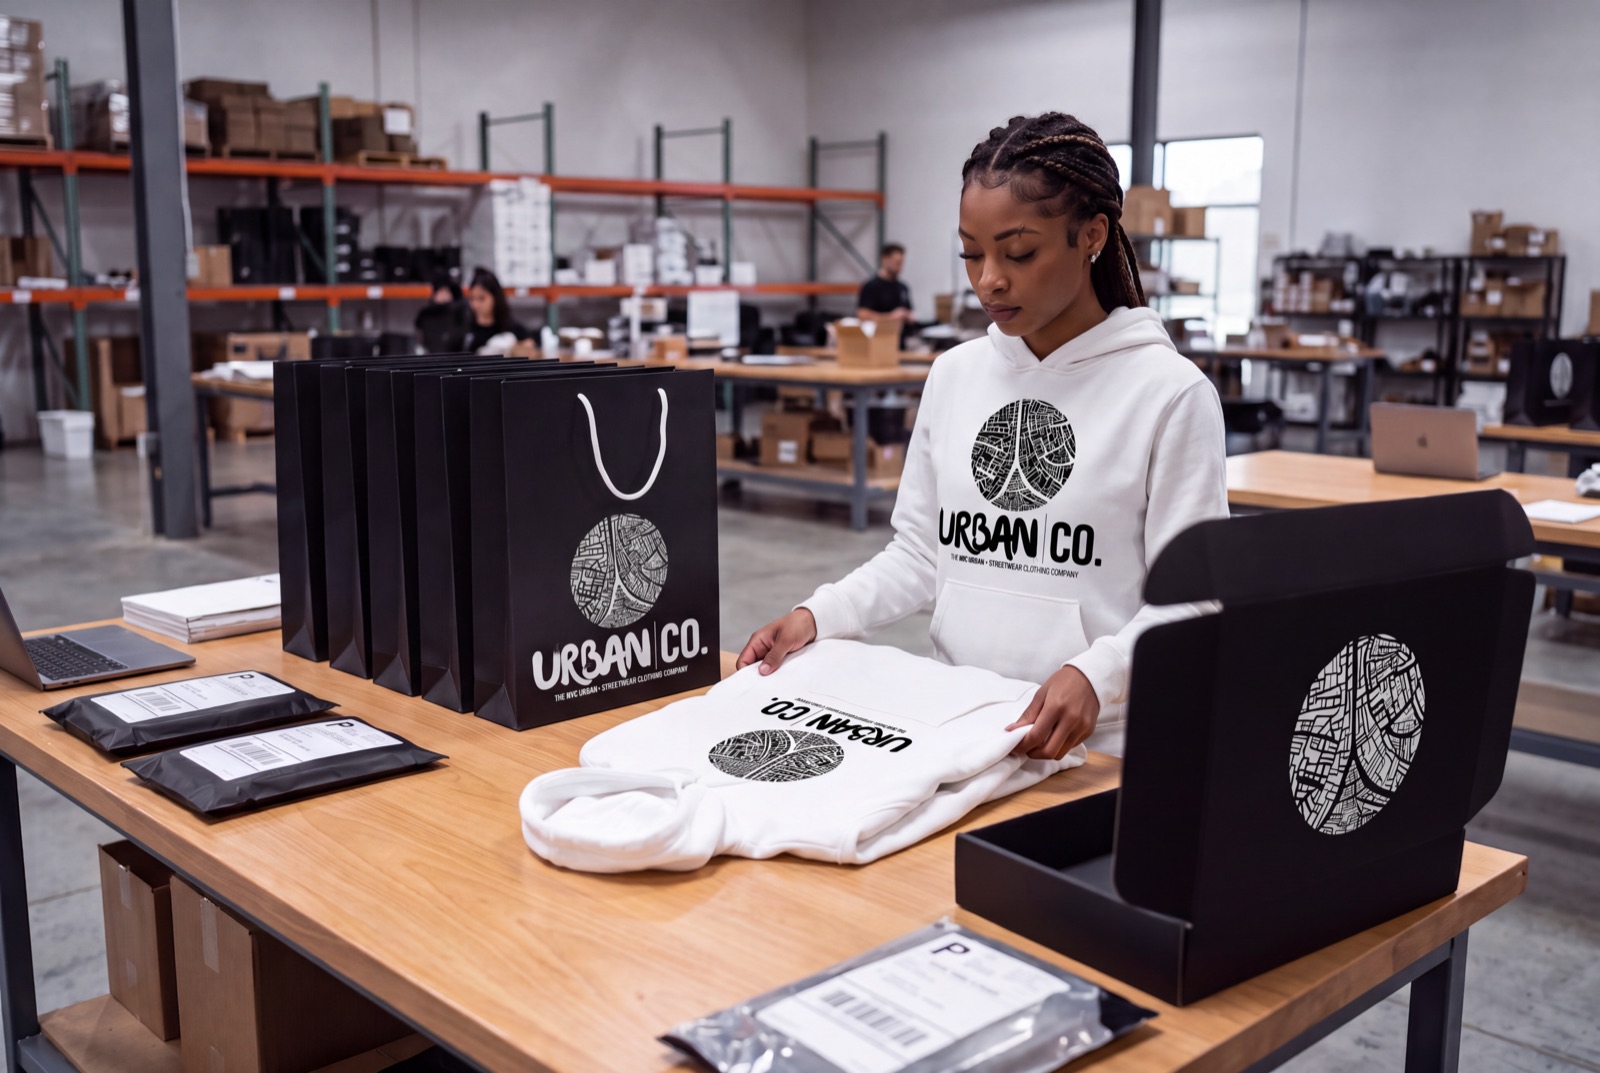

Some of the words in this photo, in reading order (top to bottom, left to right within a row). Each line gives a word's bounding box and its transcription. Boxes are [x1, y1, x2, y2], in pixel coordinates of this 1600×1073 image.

[938, 507, 1038, 561] URBAN
[1050, 521, 1102, 567] CO.
[988, 559, 1023, 572] STREETWEAR
[1022, 564, 1050, 576] CLOTHING
[1050, 568, 1079, 579] COMPANY
[532, 628, 651, 691] URBAN
[660, 617, 708, 664] CO.
[554, 692, 566, 702] THE
[578, 685, 598, 697] URBAN
[601, 676, 637, 692] STREETWEAR
[637, 670, 663, 683] CLOTHING
[663, 664, 689, 677] COMPANY
[760, 697, 811, 721] CO.
[805, 713, 913, 753] URBAN
